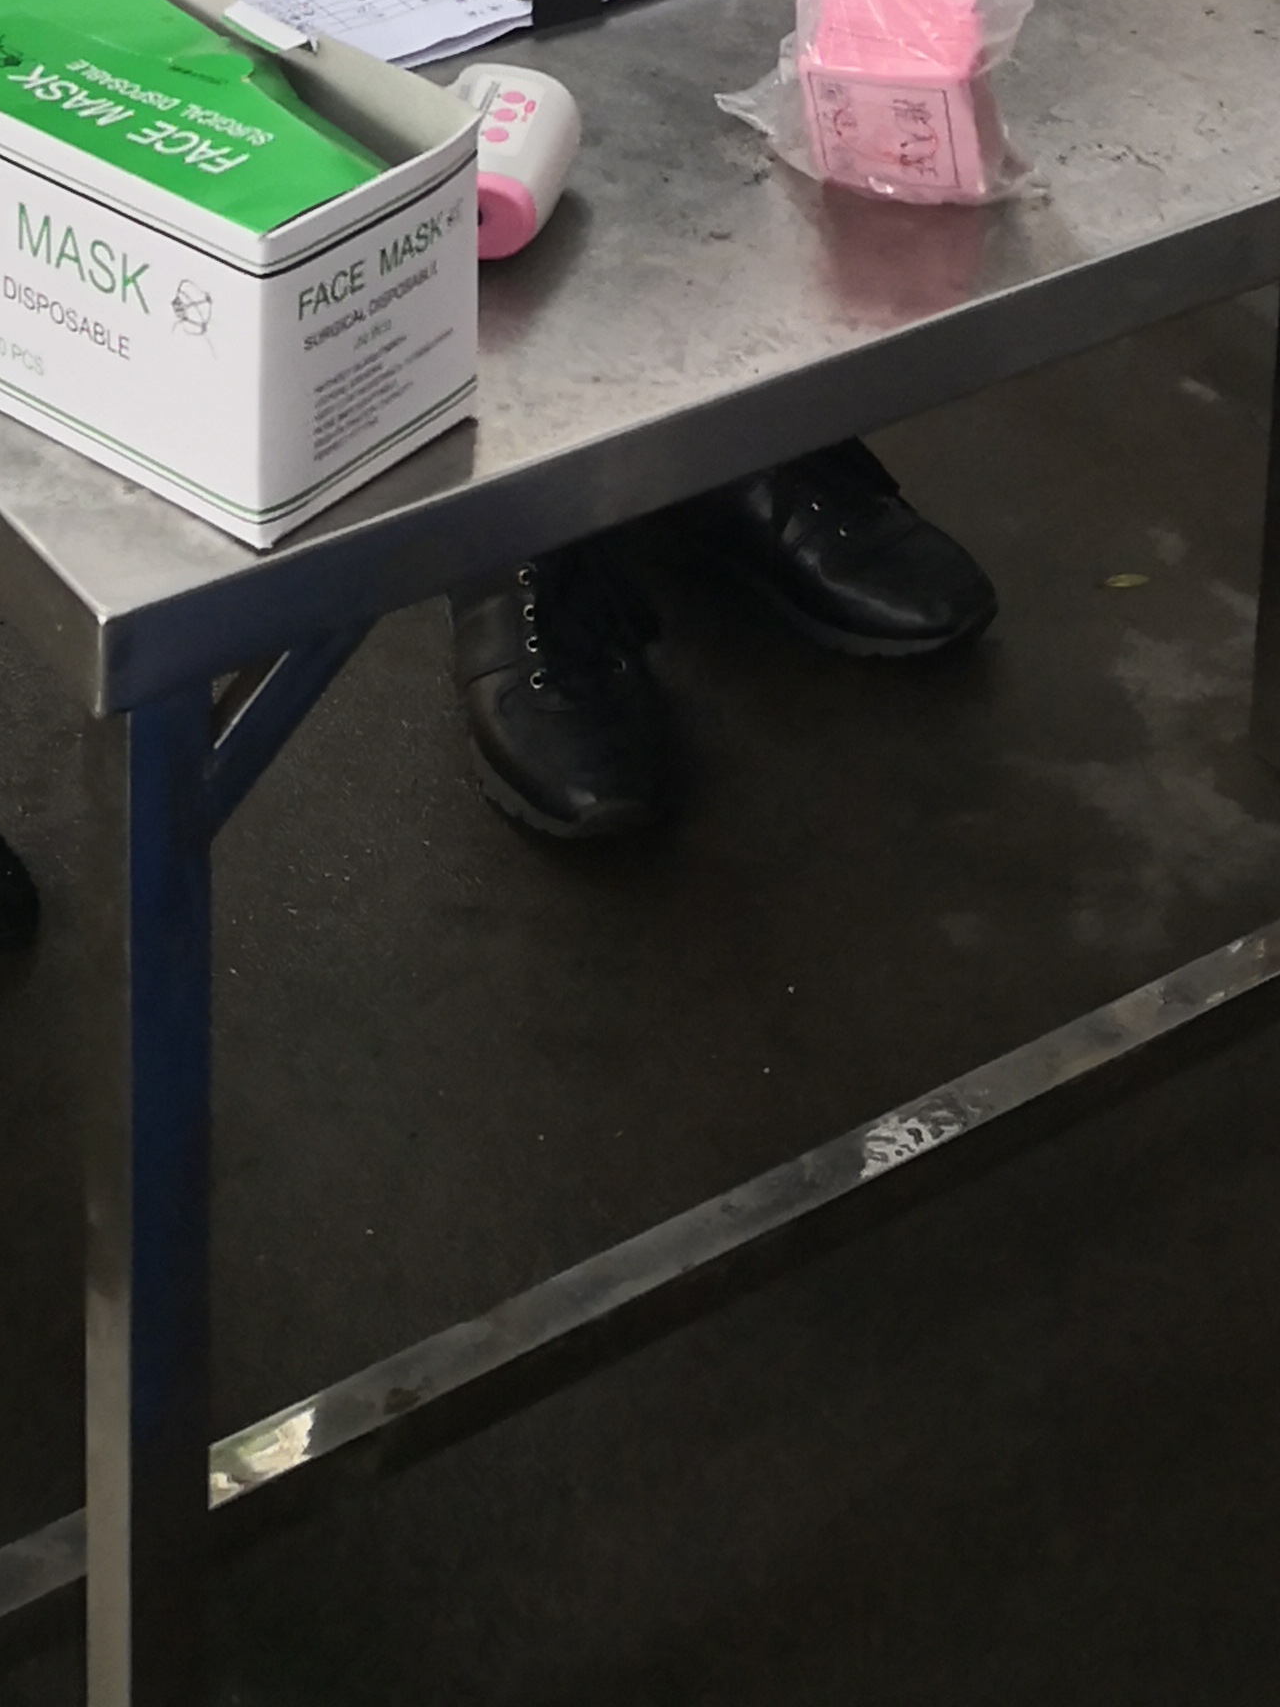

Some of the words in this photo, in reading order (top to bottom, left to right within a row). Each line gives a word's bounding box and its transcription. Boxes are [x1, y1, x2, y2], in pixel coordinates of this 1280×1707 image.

[6, 64, 136, 128] MASK
[64, 58, 182, 112] DISPOSABLE
[125, 119, 251, 175] FACE
[180, 103, 276, 147] SURGICAL
[17, 201, 151, 315] MASK
[297, 258, 367, 322] FACE
[377, 213, 445, 277] MASK
[3, 274, 131, 360] DISPOSABLE
[303, 308, 368, 351] SURGICAL
[9, 342, 45, 377] PCS
